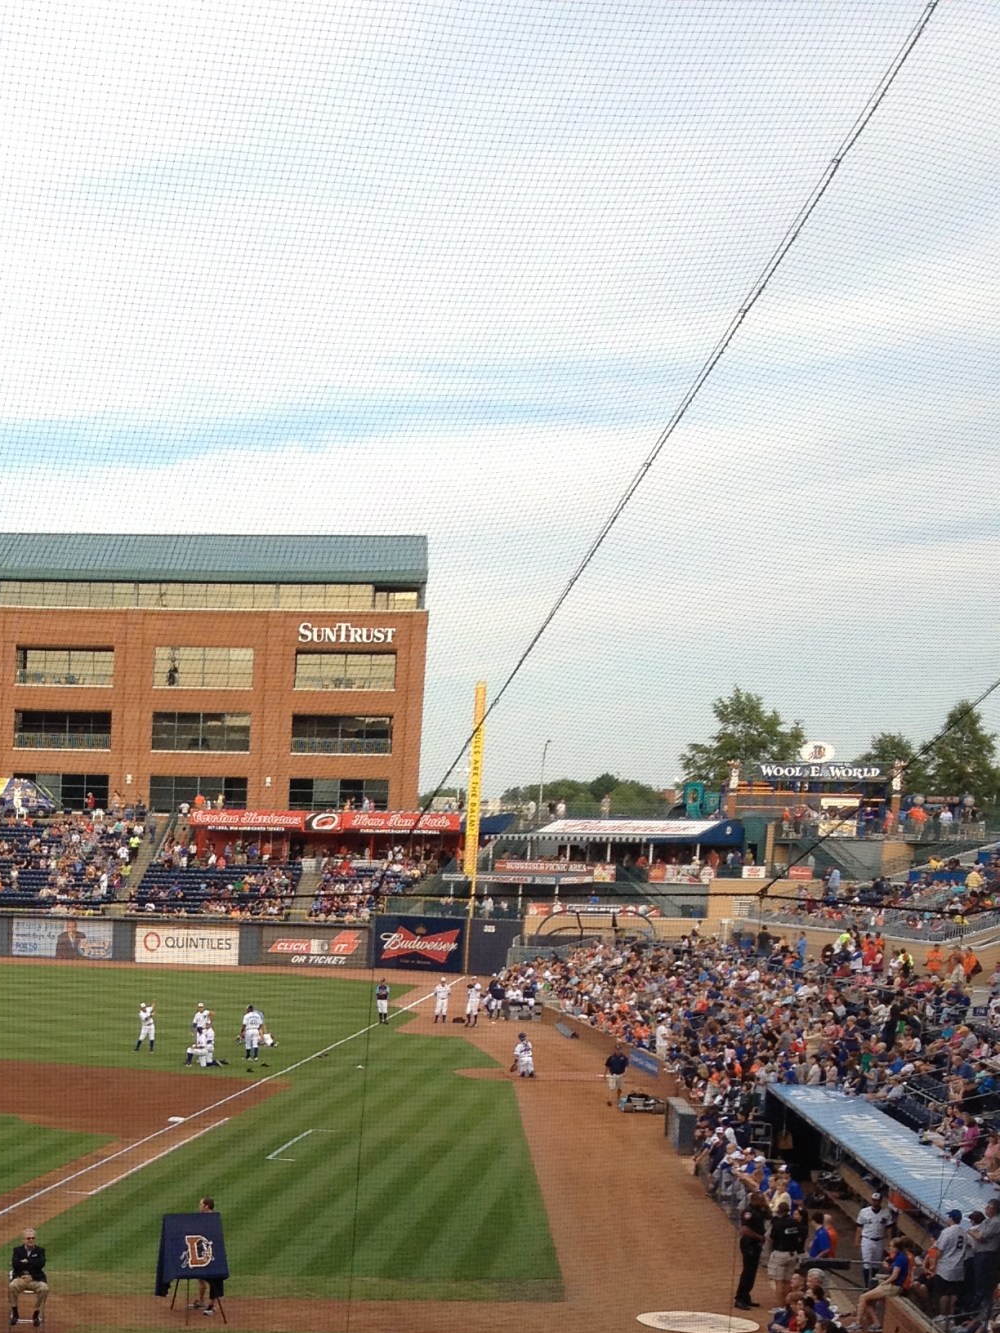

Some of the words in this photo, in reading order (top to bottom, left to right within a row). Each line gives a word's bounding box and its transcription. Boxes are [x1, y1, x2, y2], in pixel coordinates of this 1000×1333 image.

[760, 764, 803, 777] WOOL
[828, 765, 881, 778] WORLD
[164, 936, 232, 950] QUINTILES
[277, 942, 309, 951] CLICK
[380, 932, 458, 952] Budweiser
[291, 955, 308, 964] OR
